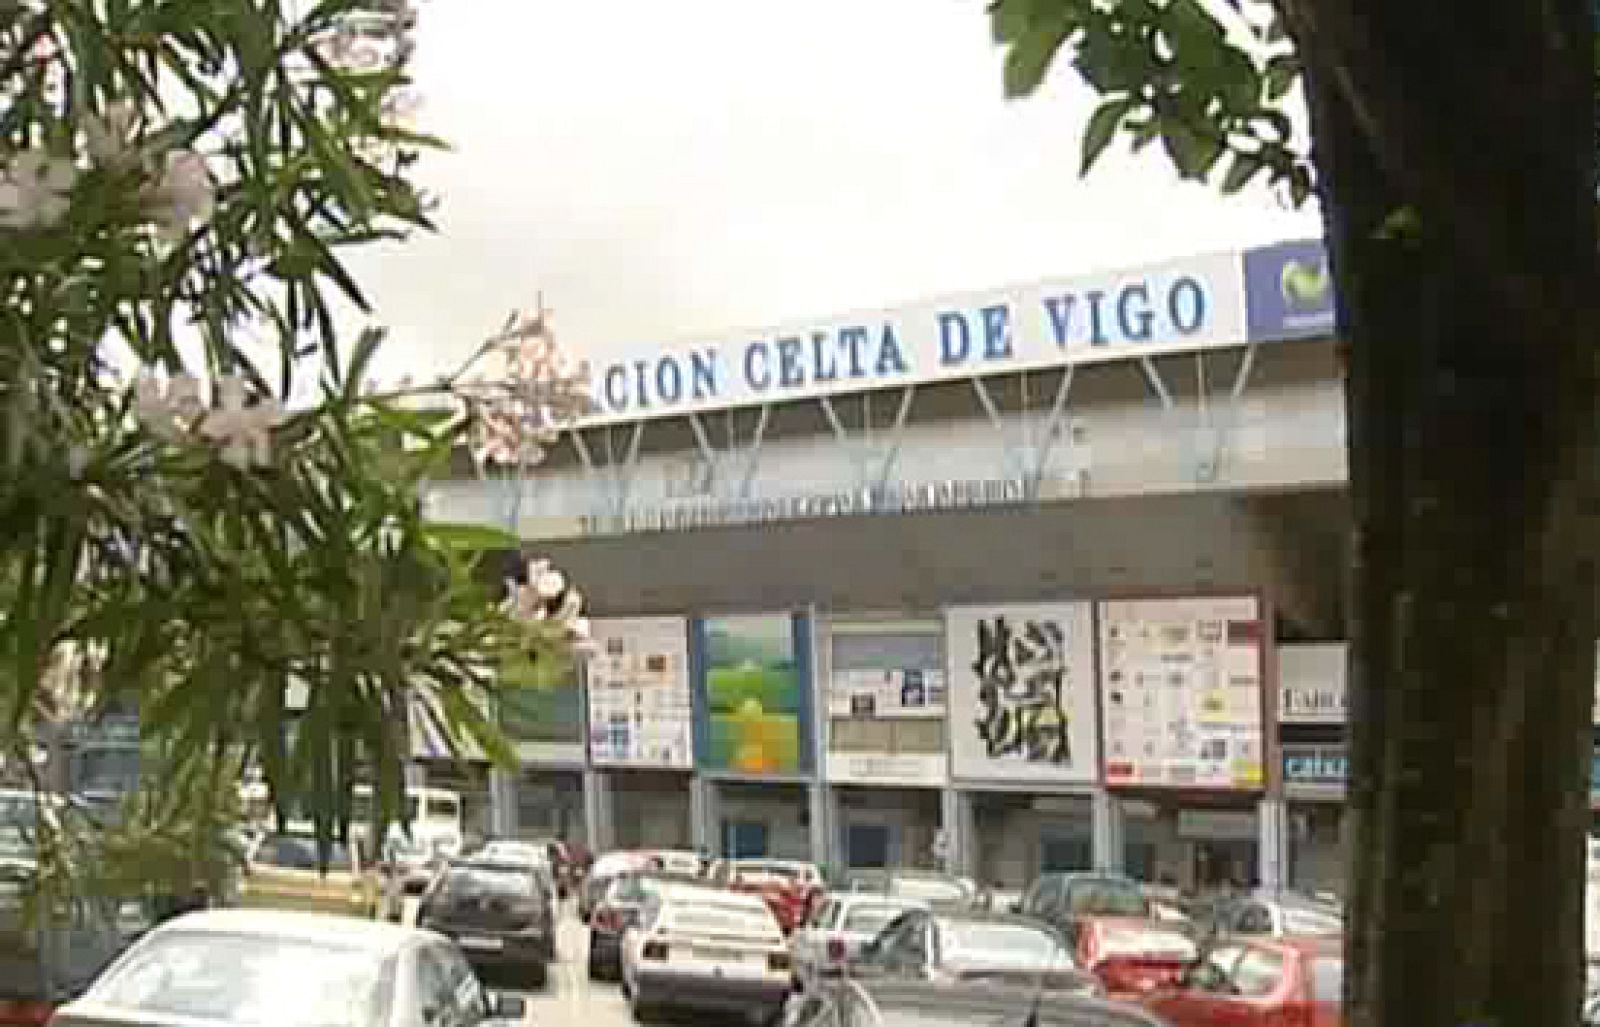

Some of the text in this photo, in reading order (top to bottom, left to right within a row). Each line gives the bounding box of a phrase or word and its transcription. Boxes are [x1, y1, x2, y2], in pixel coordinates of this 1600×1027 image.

[588, 276, 1207, 413] CION CELTA DE VIGO
